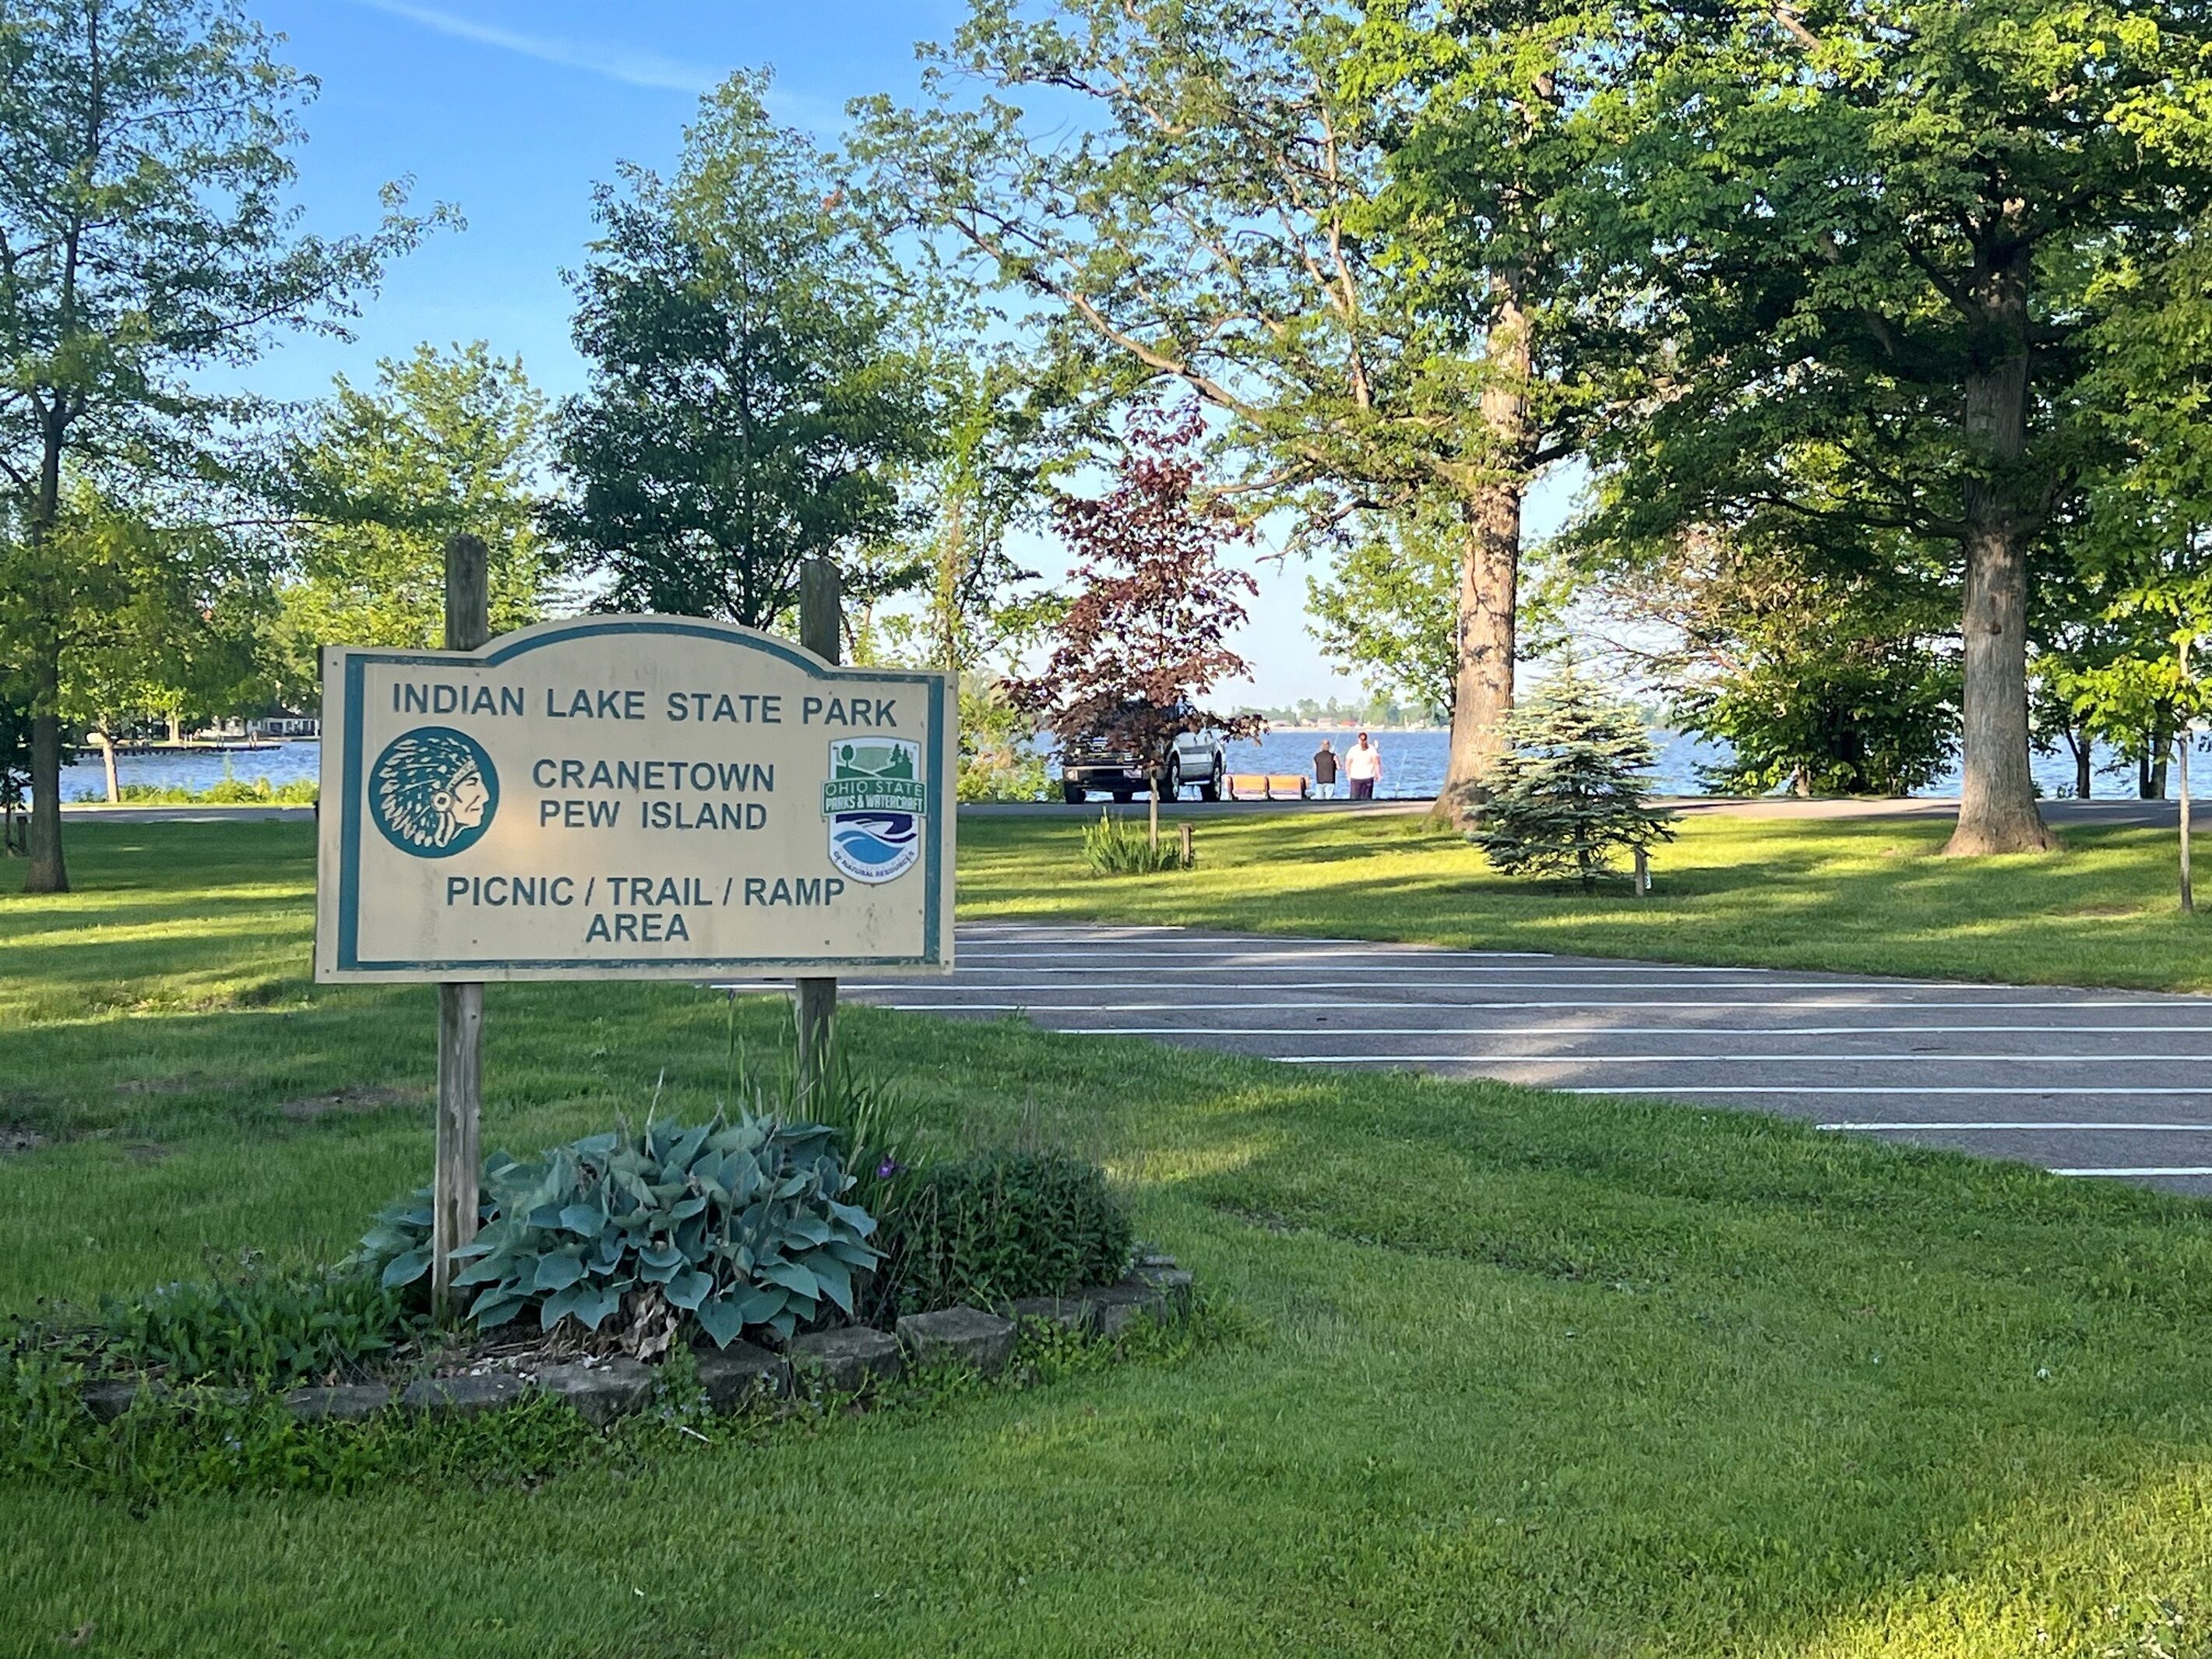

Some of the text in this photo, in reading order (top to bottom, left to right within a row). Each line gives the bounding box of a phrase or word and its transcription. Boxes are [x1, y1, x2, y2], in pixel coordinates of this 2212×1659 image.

[393, 683, 897, 727] INDIAN LAKE STATE PARK
[533, 759, 774, 792] CRANETOWN
[825, 780, 923, 797] OHIO STATE
[540, 800, 767, 830] PEW ISLAND
[447, 876, 845, 907] PICNIC / TRAIL / RAMP
[585, 914, 690, 942] AREA
